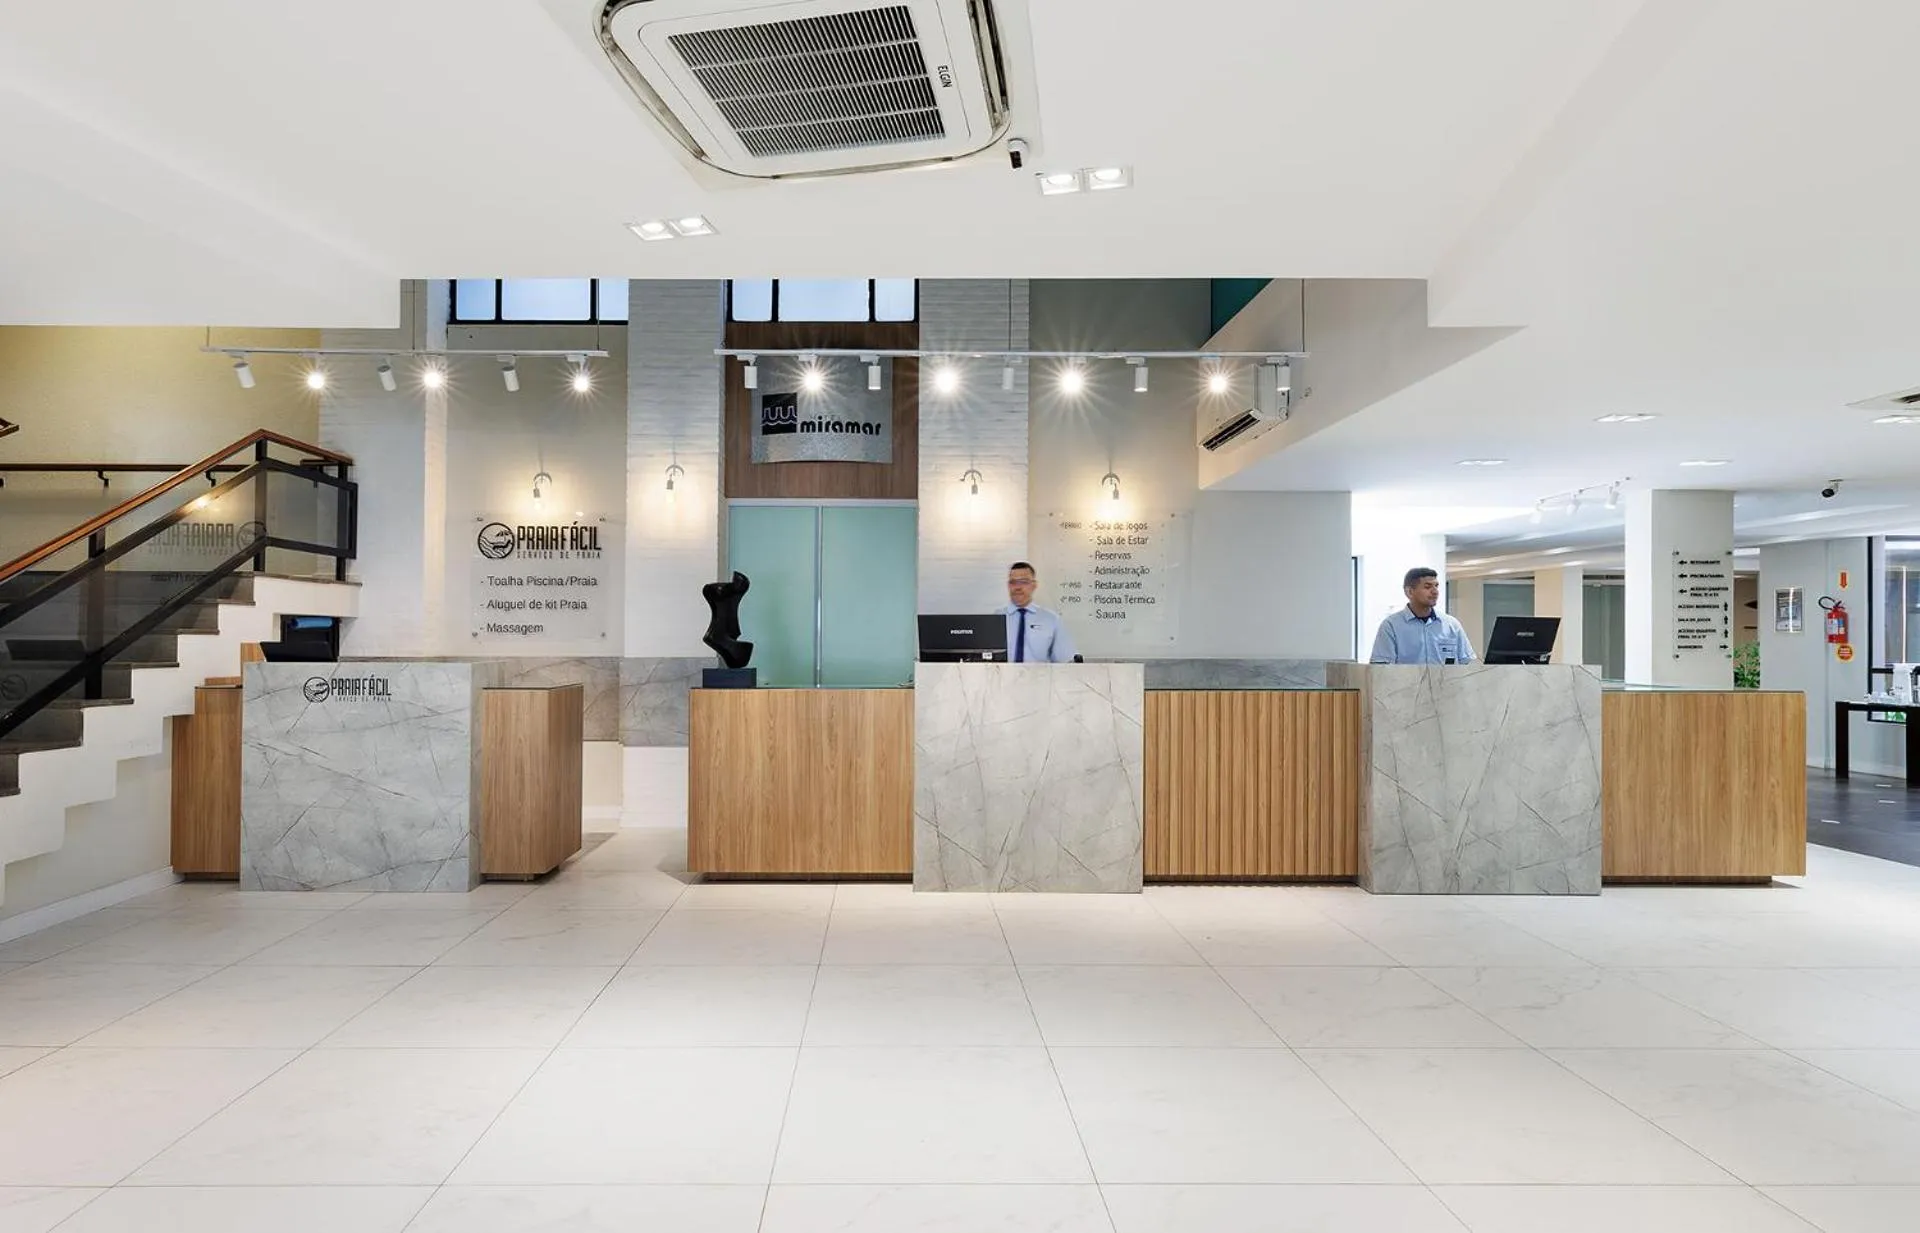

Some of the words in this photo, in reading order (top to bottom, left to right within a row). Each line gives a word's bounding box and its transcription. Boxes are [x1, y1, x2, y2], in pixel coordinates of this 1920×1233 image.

[937, 64, 952, 88] ELGIN
[800, 415, 882, 436] miramar
[516, 521, 602, 550] PRAIAFÁCIL
[1096, 536, 1113, 545] Sala
[1116, 536, 1125, 545] de
[1128, 535, 1148, 545] Estar
[1095, 550, 1132, 560] Reservas
[1094, 566, 1150, 577] Administração
[487, 576, 524, 586] Toalha
[1095, 580, 1142, 590] Restaurante
[1094, 595, 1122, 604] Piscina
[486, 600, 526, 612] Aluguel
[529, 600, 543, 610] de
[545, 600, 557, 610] kit
[560, 600, 588, 610] Praia
[1096, 609, 1126, 619] Sauna
[487, 623, 544, 635] Massagem
[331, 674, 392, 696] PRAIAFÁCIL
